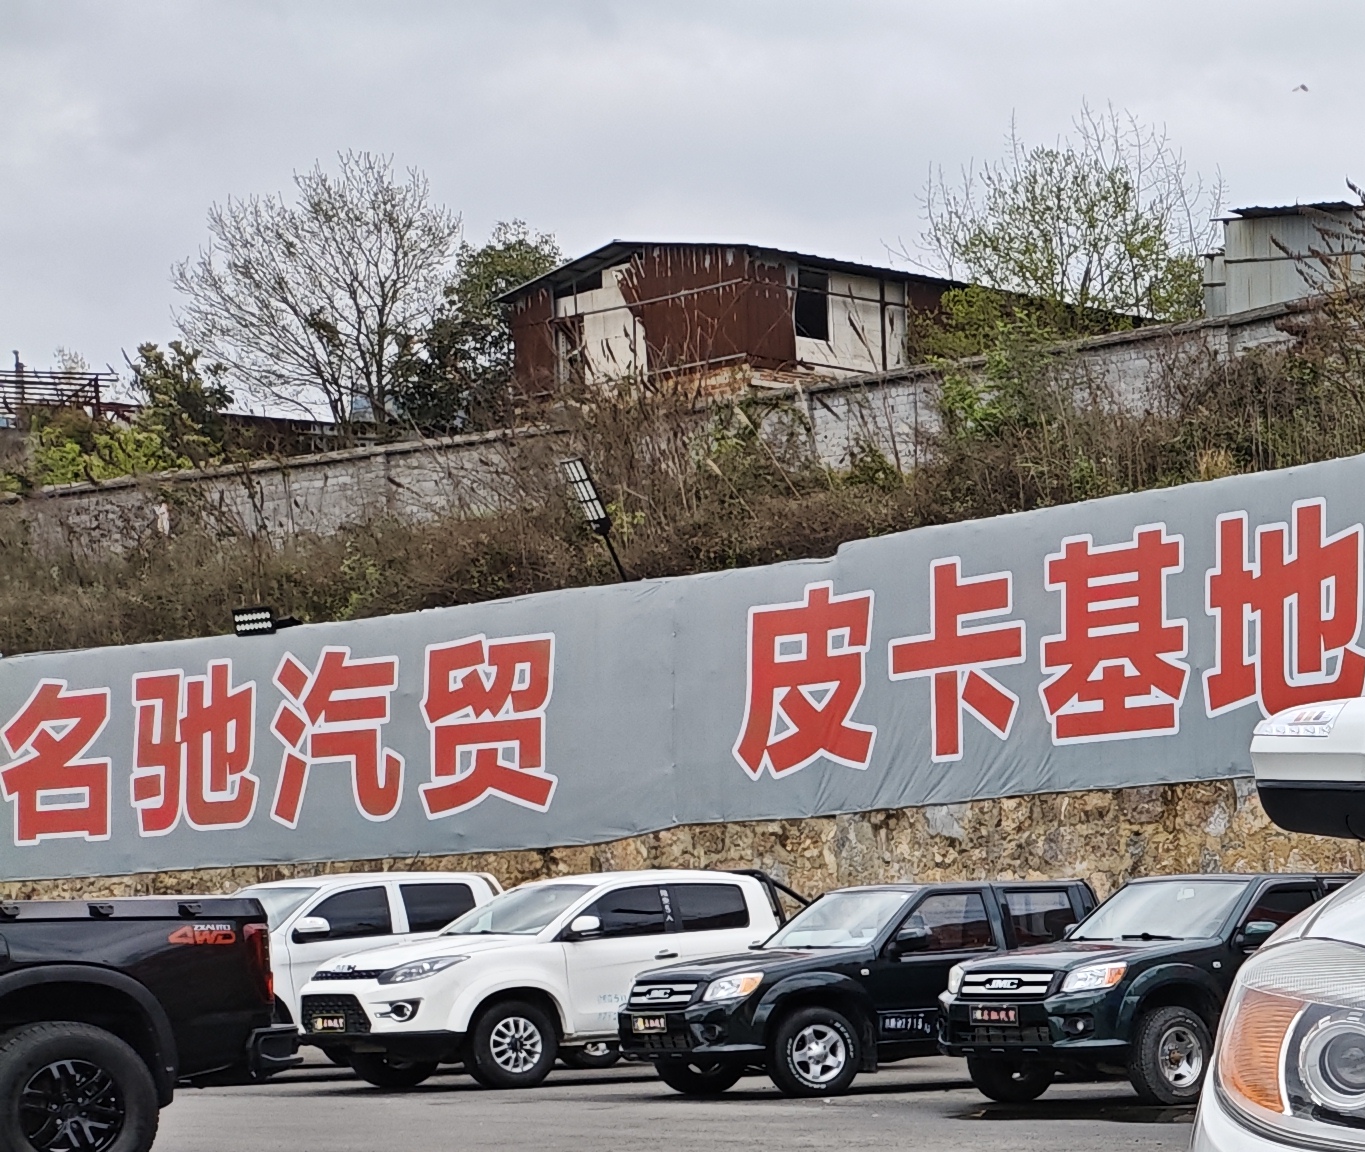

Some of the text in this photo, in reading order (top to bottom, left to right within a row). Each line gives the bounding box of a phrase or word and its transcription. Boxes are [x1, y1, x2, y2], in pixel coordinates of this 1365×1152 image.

[0, 634, 558, 846] 名驰汽贸
[167, 925, 236, 945] 4WD
